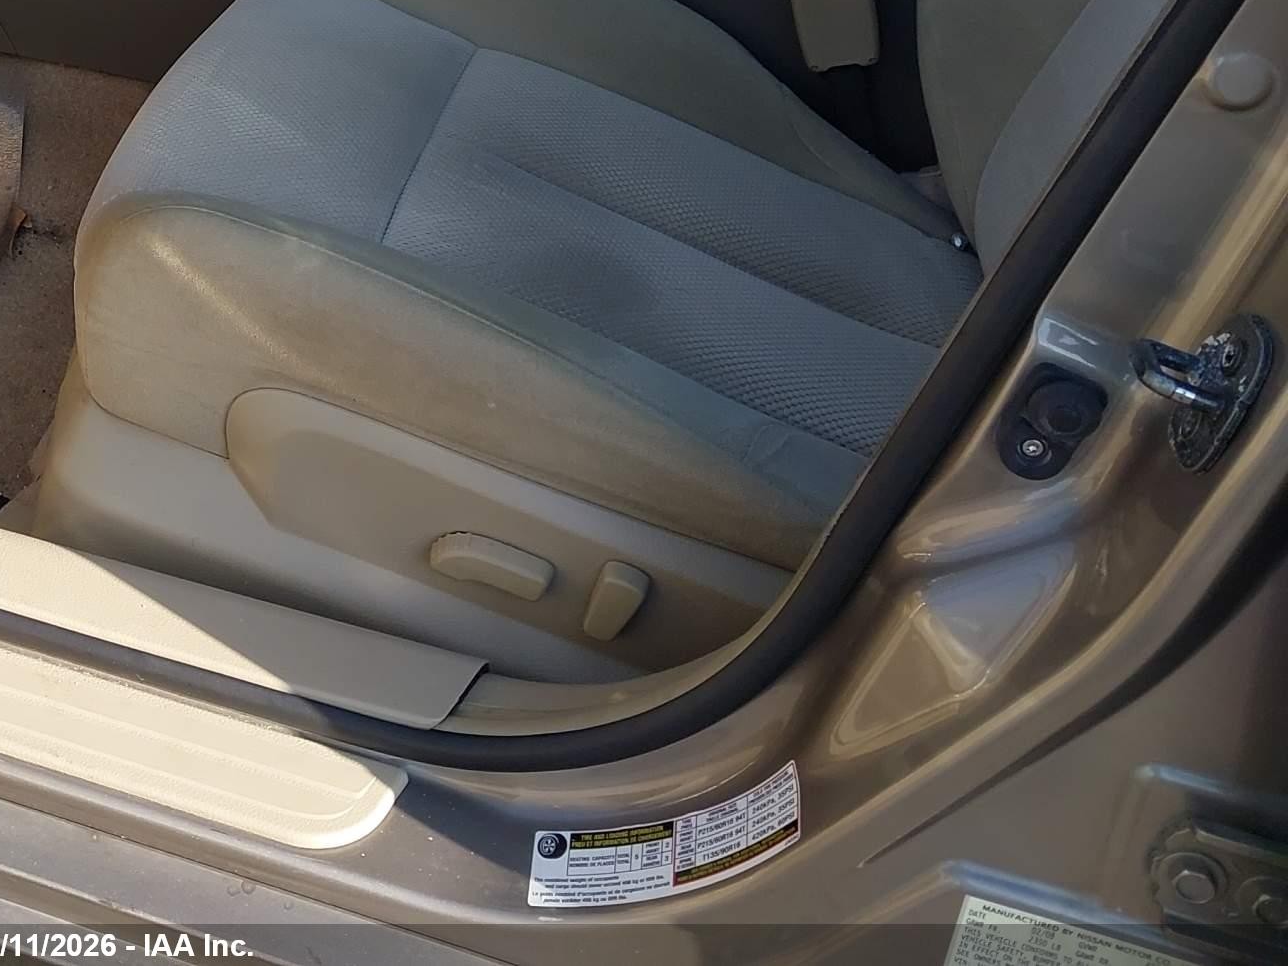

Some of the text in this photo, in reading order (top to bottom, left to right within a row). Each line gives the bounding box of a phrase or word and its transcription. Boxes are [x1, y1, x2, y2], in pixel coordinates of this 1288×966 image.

[968, 909, 986, 920] DATE
[962, 934, 992, 947] VEHICLE
[964, 926, 980, 937] THIS
[986, 934, 1016, 947] VEHICLE
[982, 905, 1060, 932] MANUFACTURED
[1077, 933, 1112, 948] NISSAN
[1115, 944, 1152, 960] MOTOR
